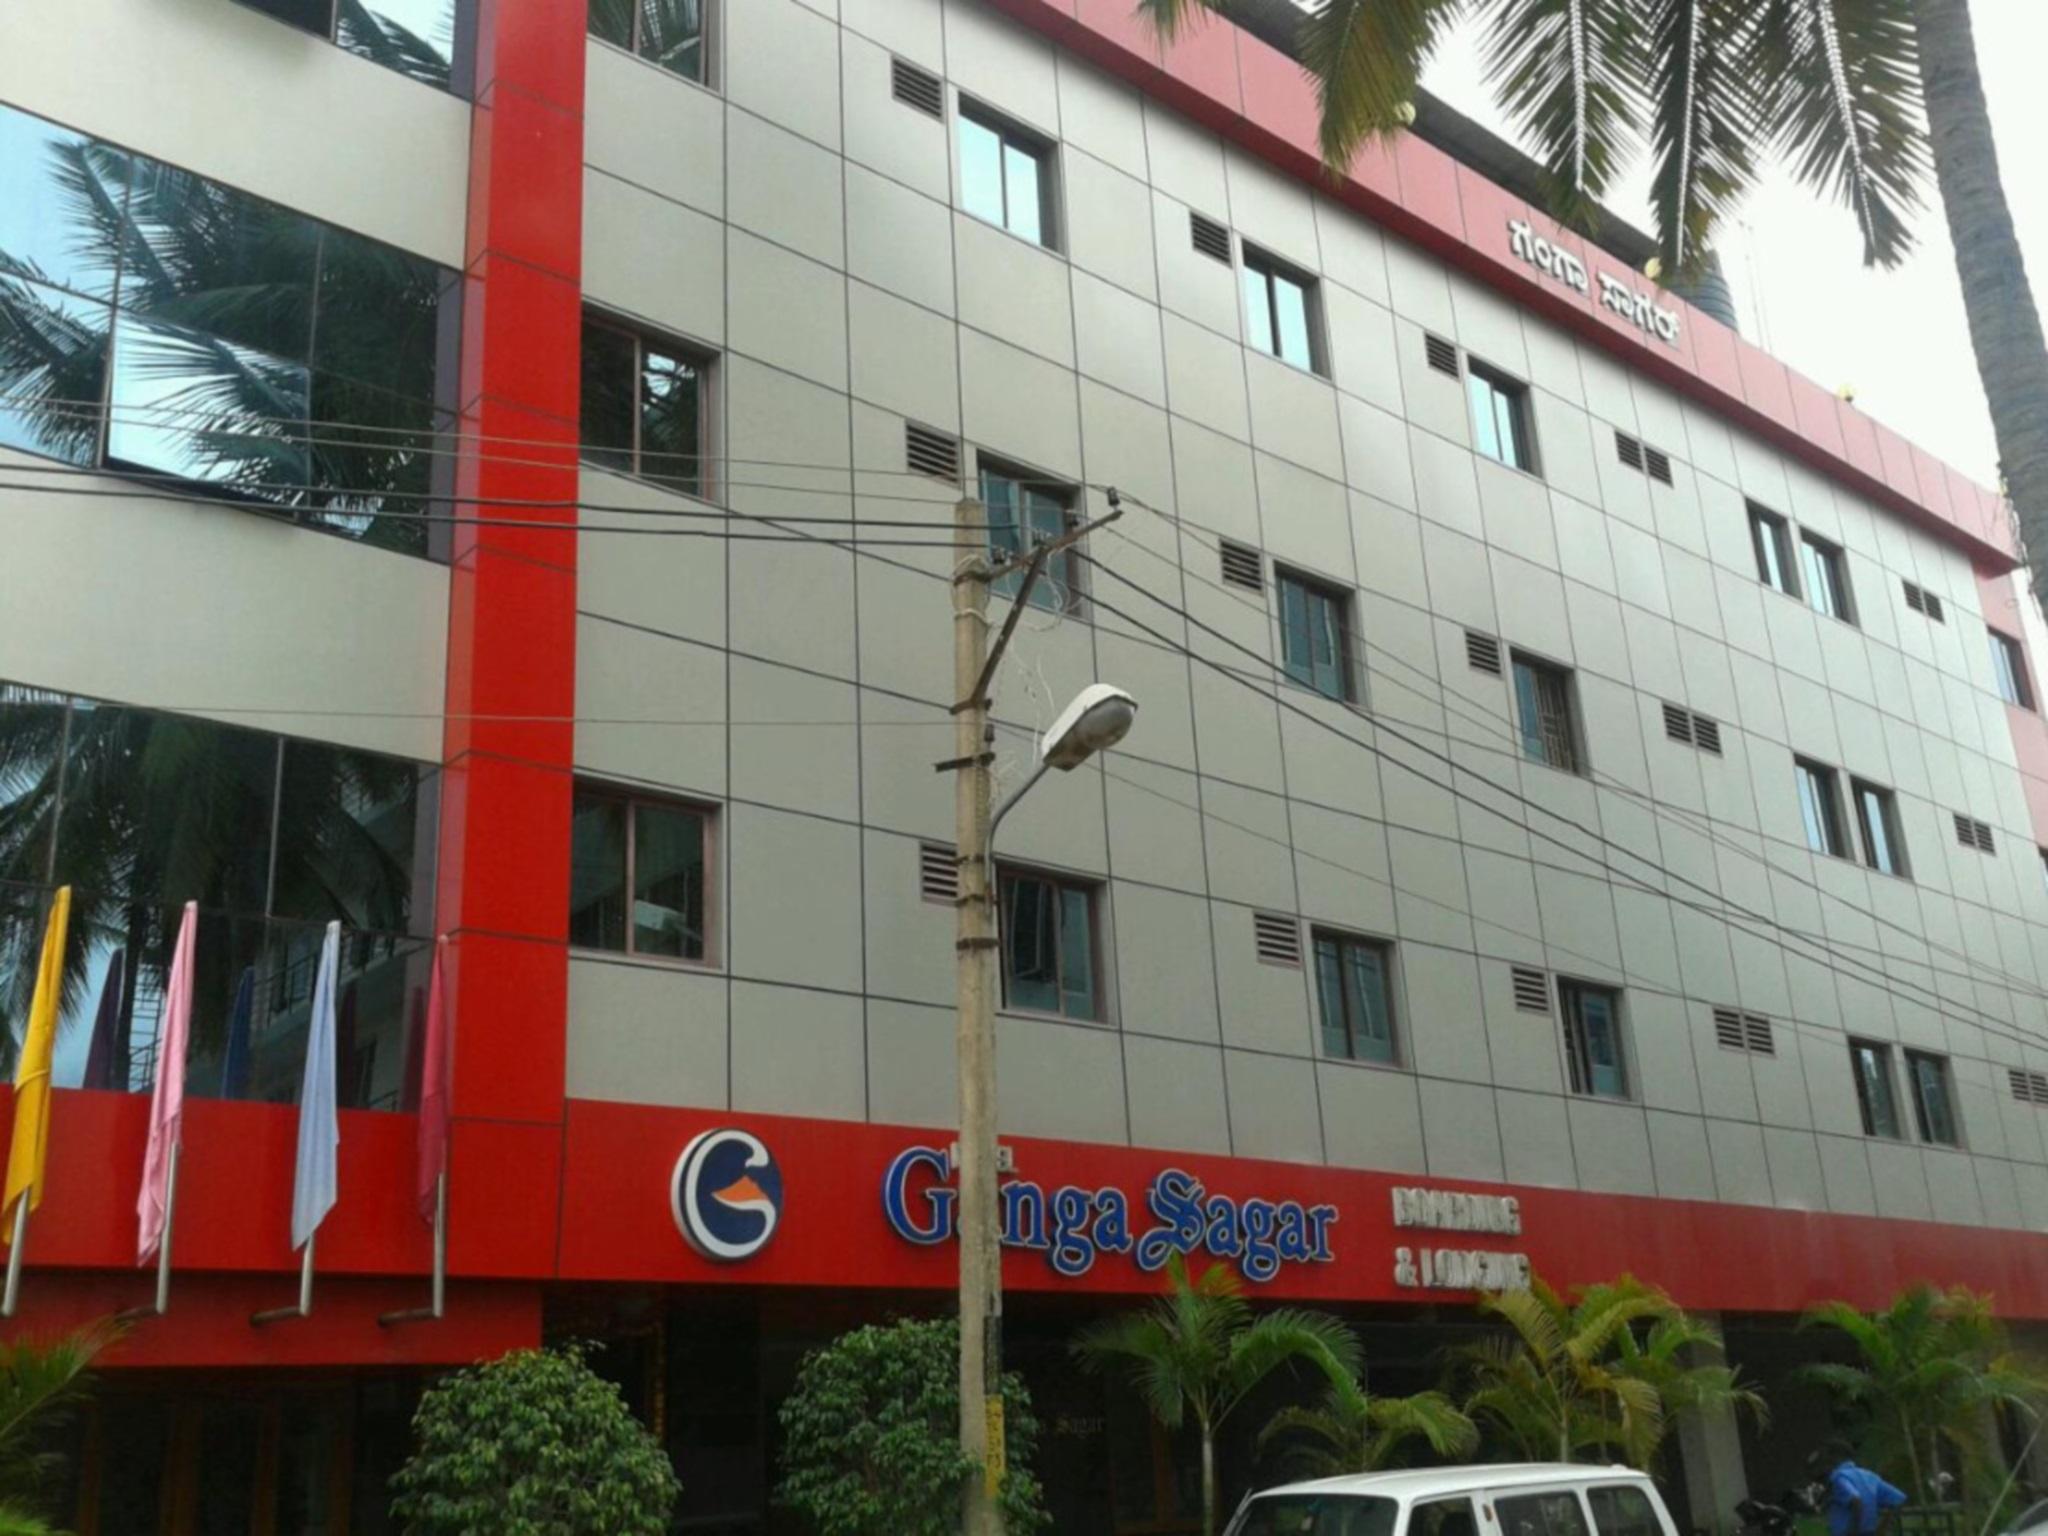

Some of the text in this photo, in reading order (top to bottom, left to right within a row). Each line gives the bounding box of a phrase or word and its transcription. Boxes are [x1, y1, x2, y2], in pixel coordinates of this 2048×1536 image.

[883, 1146, 1339, 1282] Gnga Sagar
[1394, 1246, 1419, 1287] &
